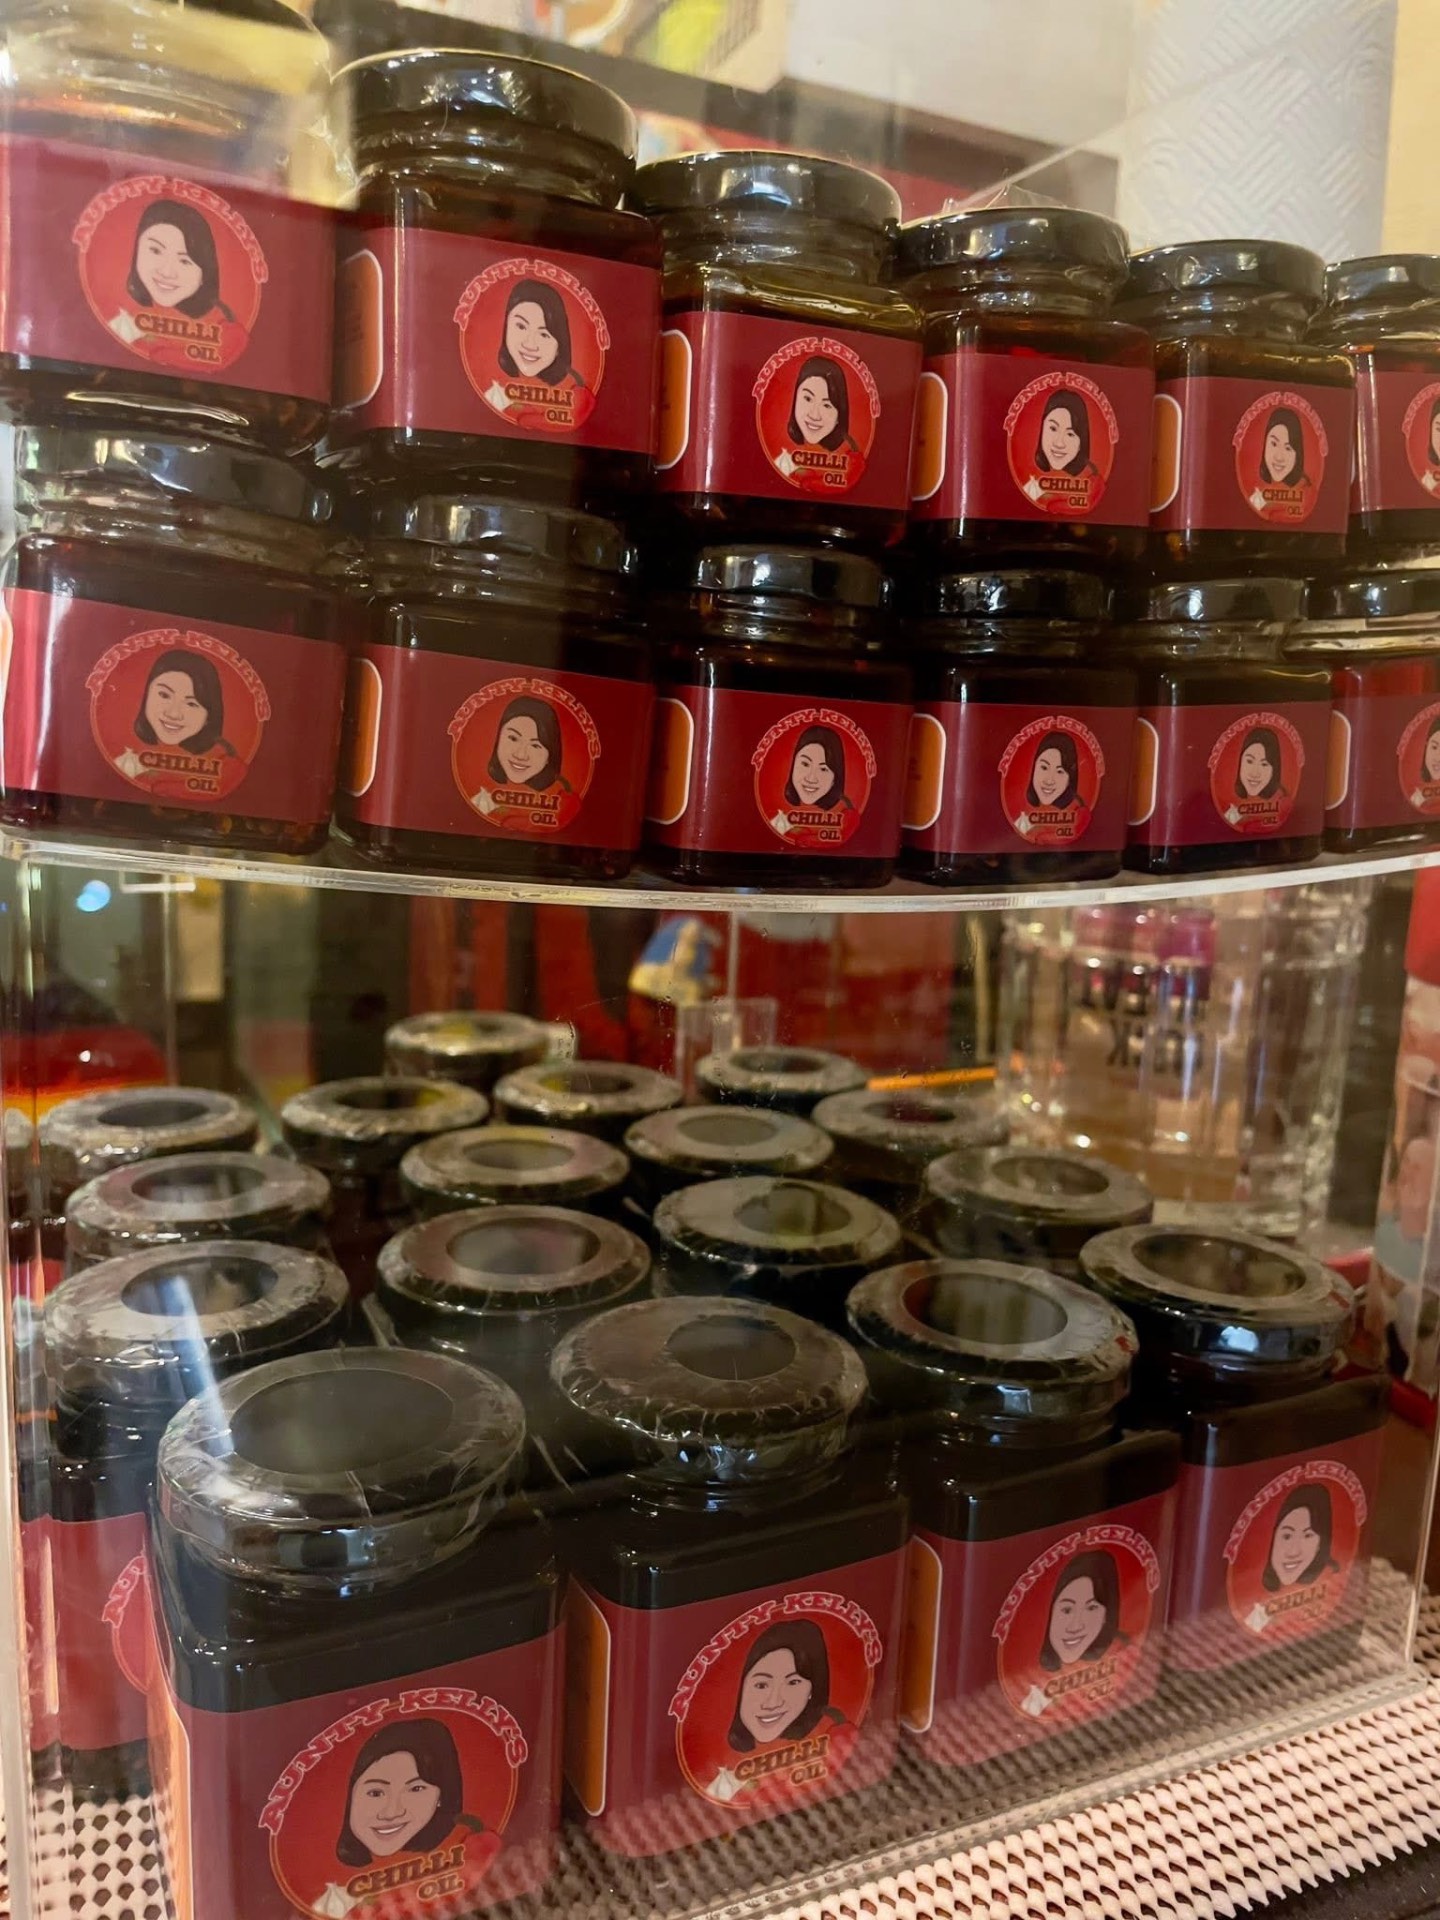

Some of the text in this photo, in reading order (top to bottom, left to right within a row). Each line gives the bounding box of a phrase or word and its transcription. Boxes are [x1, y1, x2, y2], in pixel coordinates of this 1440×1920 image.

[72, 175, 166, 252] AUNTY
[453, 258, 529, 331] AUNTY
[134, 312, 222, 344] CHILLI
[186, 345, 222, 363] OIL
[752, 337, 818, 405] AUNTY
[505, 383, 574, 408] CHILLI
[1003, 372, 1062, 436] AUNTY
[546, 409, 574, 425] OIL
[791, 450, 849, 471] CHILLI
[824, 473, 846, 487] OIL
[1039, 477, 1089, 493] CHILLI
[1068, 496, 1088, 507] OIL
[1262, 489, 1303, 503] CHILLI
[85, 629, 180, 697] AUNTY
[447, 677, 526, 743] AUNTY
[751, 708, 816, 771] AUNTY
[138, 751, 221, 776] CHILLI
[187, 777, 219, 793] OIL
[491, 789, 560, 810] CHILLI
[1238, 801, 1279, 814] CHILLI
[530, 811, 558, 826] OIL
[787, 811, 844, 827] CHILLI
[1028, 812, 1075, 824] CHILLI
[818, 829, 841, 841] OIL
[1055, 827, 1074, 837] OIL
[101, 1553, 148, 1629] AUN
[992, 1532, 1081, 1644] AUNTY
[668, 1600, 776, 1722] AUNTY
[258, 1698, 389, 1835] AUNTY
[735, 1735, 830, 1781] CHILLI
[790, 1760, 828, 1785] OIL
[347, 1845, 465, 1898] CHILLI
[416, 1875, 463, 1900] OIL
